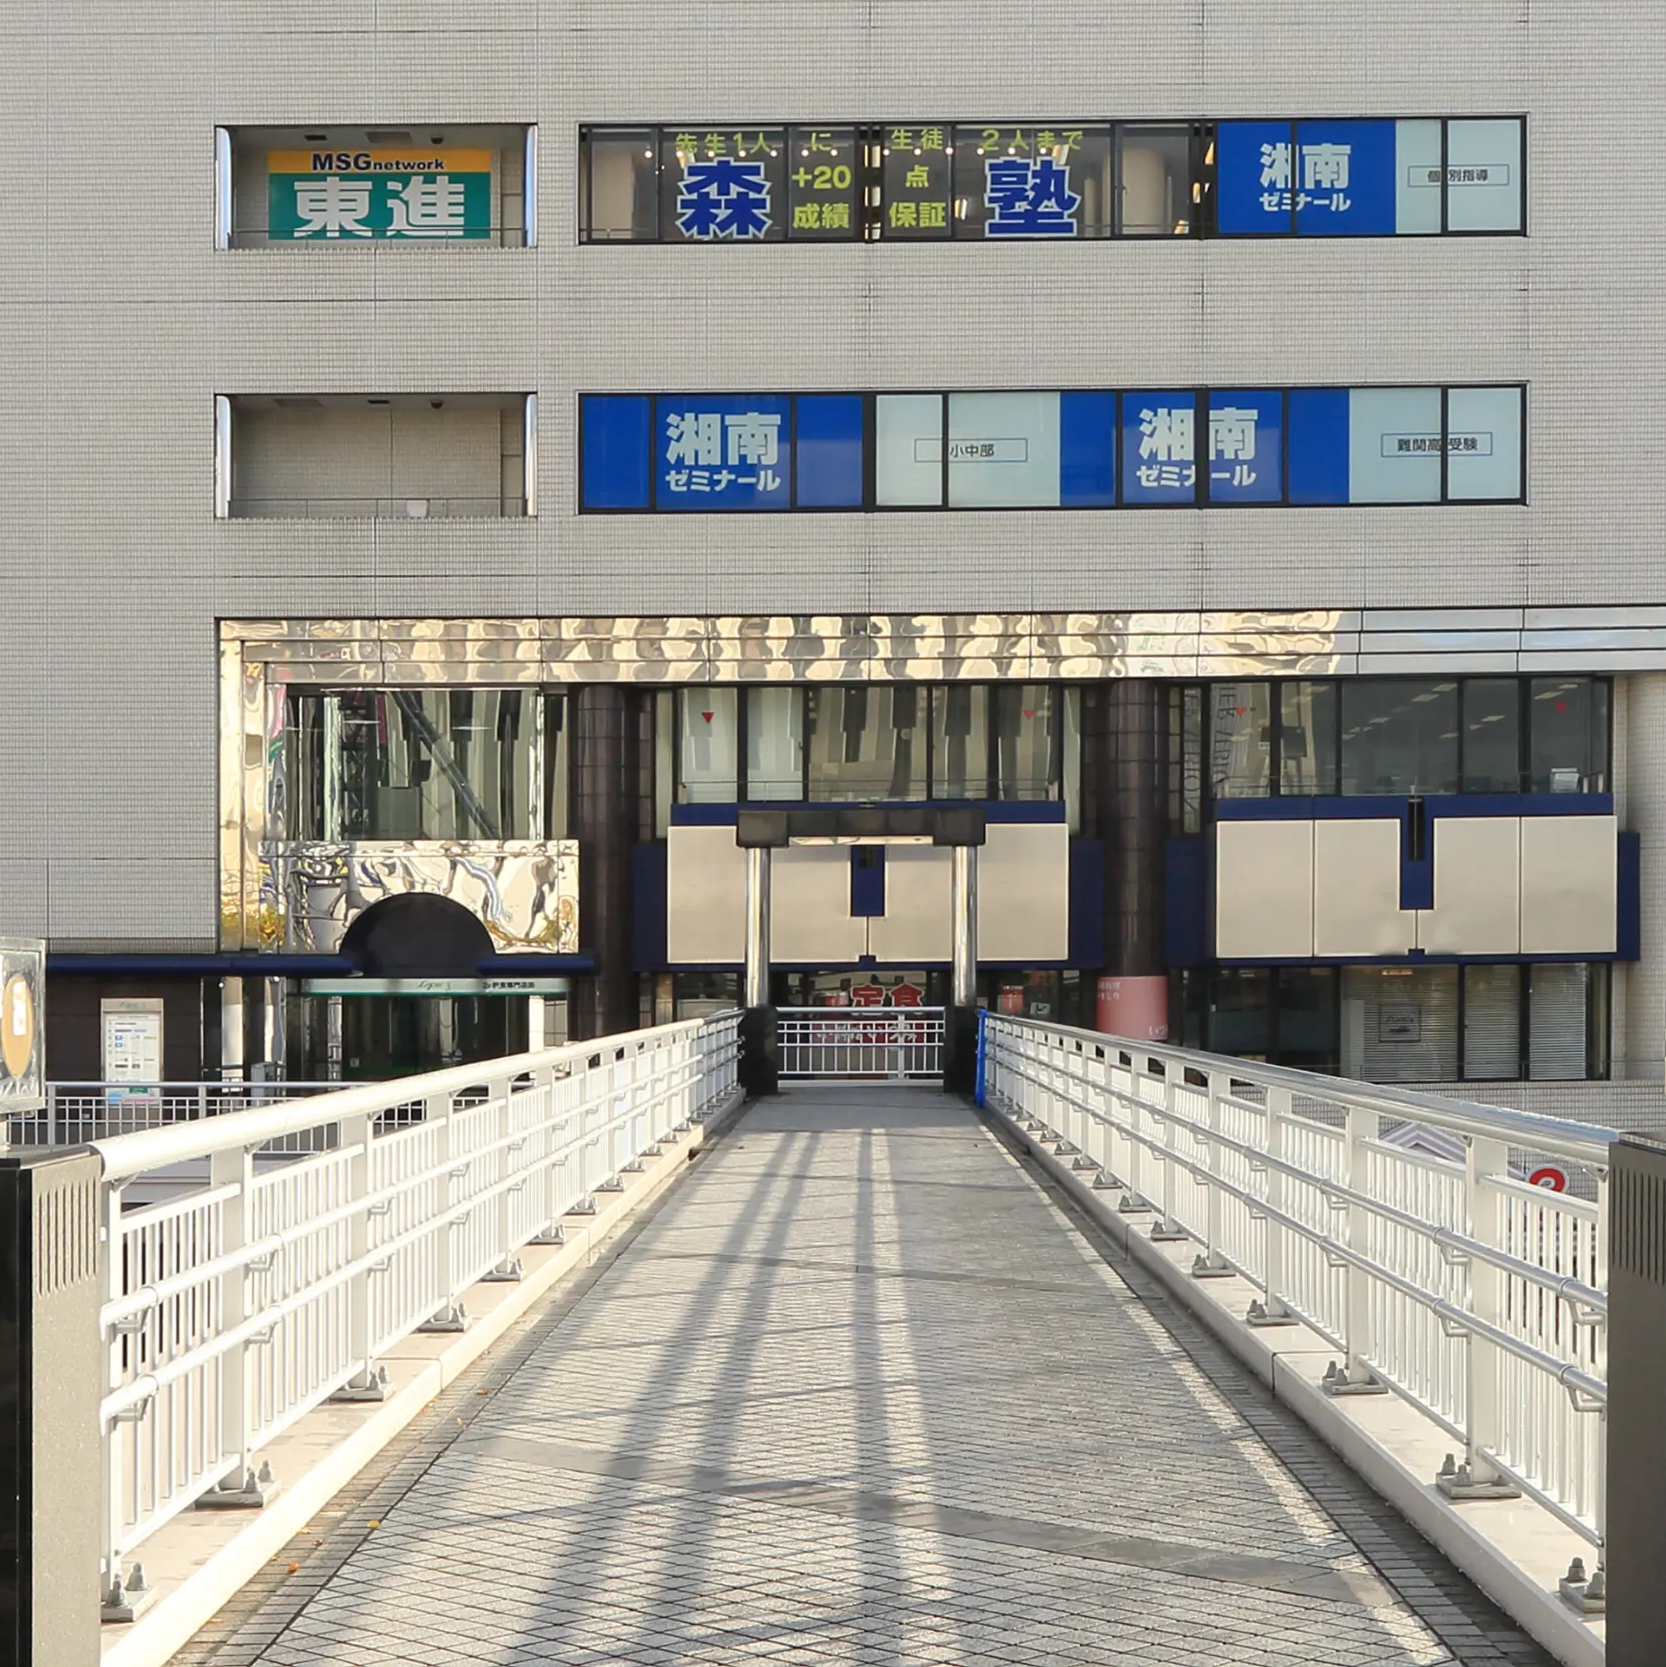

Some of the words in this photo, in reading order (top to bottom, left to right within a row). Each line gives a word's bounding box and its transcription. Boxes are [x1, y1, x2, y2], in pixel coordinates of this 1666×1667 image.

[1259, 142, 1352, 189] 湘南
[293, 174, 466, 239] 東進
[1259, 192, 1352, 213] ゼミナール
[664, 412, 781, 466] 湘南
[949, 443, 995, 458] 小中部
[1138, 407, 1258, 461] 湘南
[664, 469, 781, 493] ゼミナール
[1136, 465, 1257, 488] ゼミナール
[850, 983, 925, 1016] 定食
